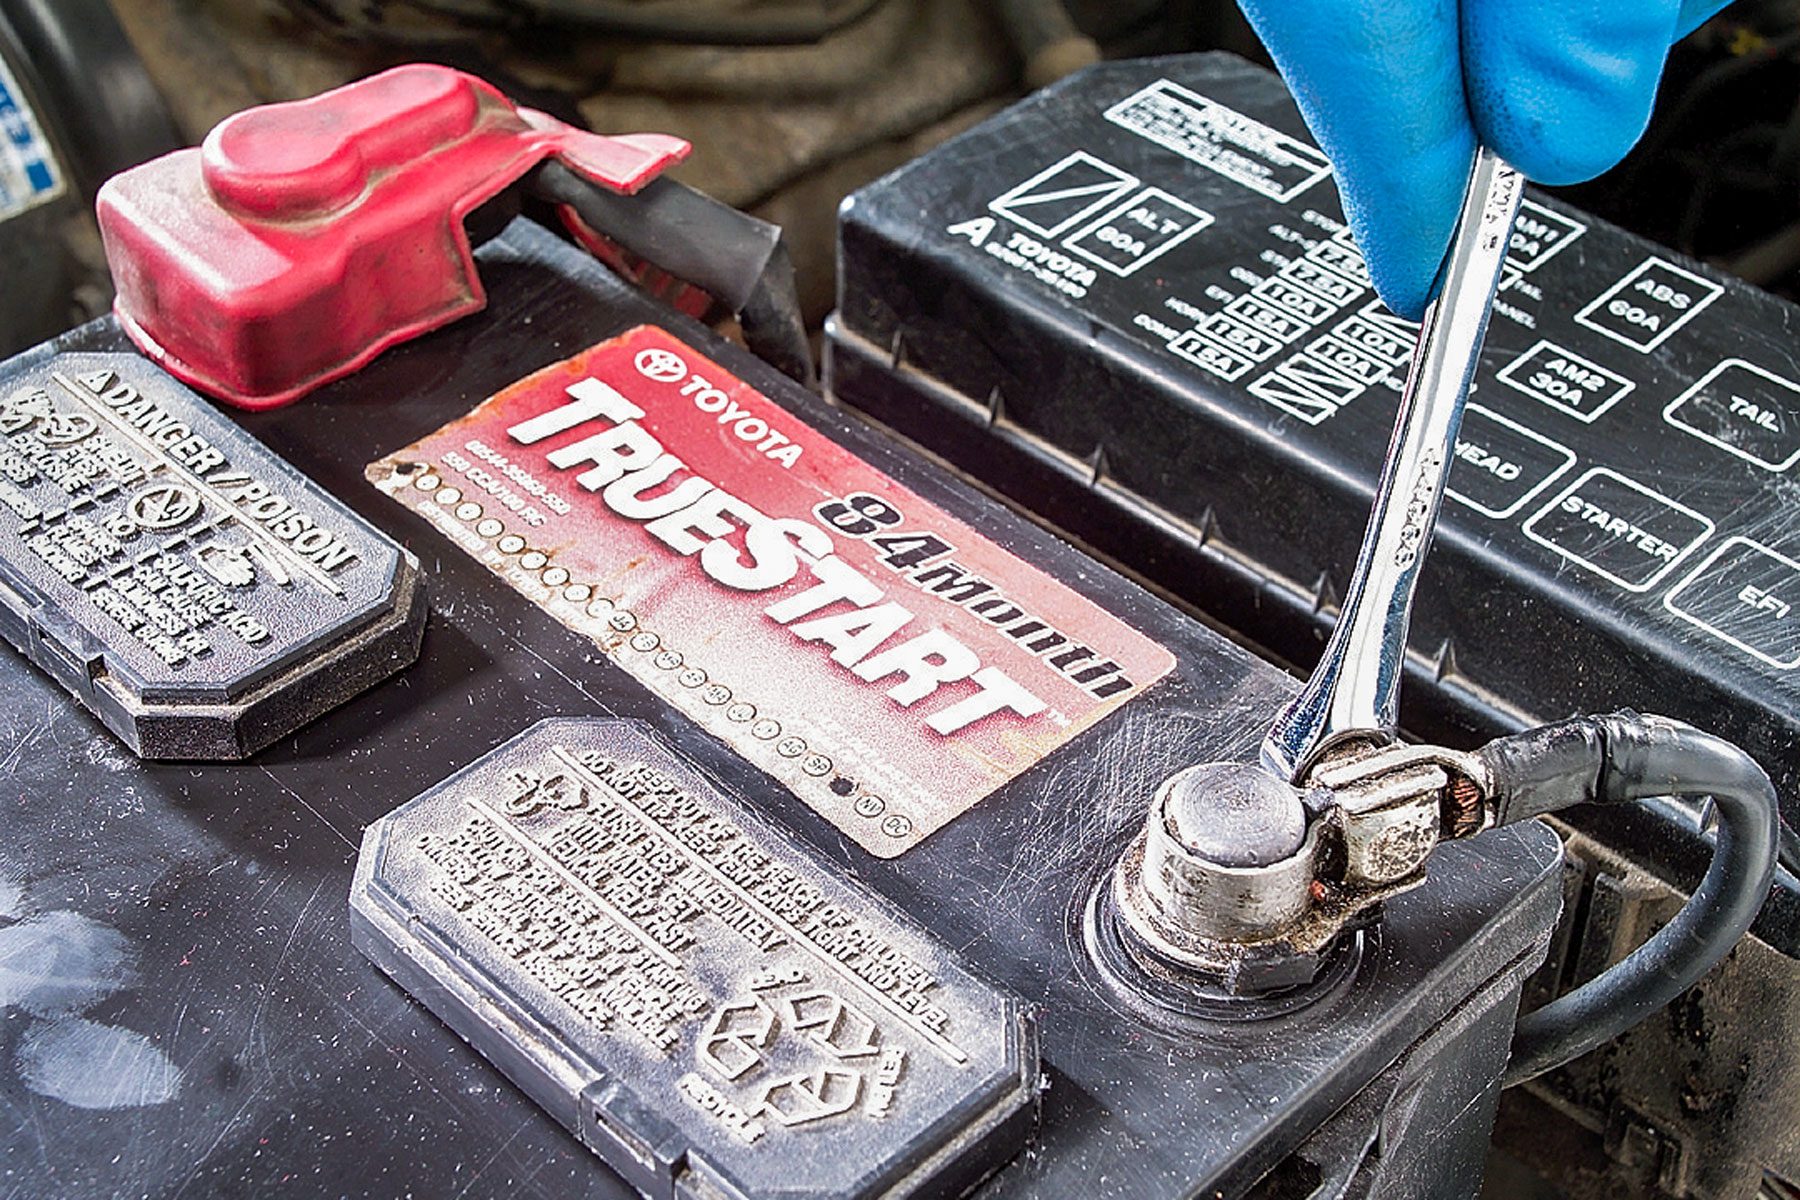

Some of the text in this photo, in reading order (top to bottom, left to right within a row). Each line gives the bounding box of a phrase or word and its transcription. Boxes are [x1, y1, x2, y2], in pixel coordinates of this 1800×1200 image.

[1126, 207, 1182, 236] ALT
[1007, 232, 1097, 286] TOYOTA
[1510, 233, 1539, 256] 0A
[1270, 284, 1318, 315] 10A
[1608, 300, 1663, 332] 60A
[1634, 278, 1691, 310] ABS
[1216, 321, 1264, 351] 15A
[1243, 302, 1290, 332] 15A
[1353, 324, 1400, 354] 10A
[1184, 340, 1233, 369] 15A
[1326, 342, 1372, 373] 10A
[1544, 357, 1606, 391] AM2
[1529, 372, 1584, 406] 30A
[680, 374, 804, 469] TOYOTA
[1730, 396, 1781, 432] TAIL
[4, 431, 90, 493] EXPLOSIVE
[59, 445, 105, 478] EYES
[81, 434, 142, 478] SHIELD
[99, 383, 226, 474] DANGER
[229, 482, 355, 572] POISON
[441, 451, 547, 528] 550 CCA/100 RC
[99, 512, 137, 538] NO
[1561, 496, 1680, 562] STARTER
[107, 575, 209, 654] BLINDNESS OR
[130, 565, 212, 626] CAN CAUSE
[150, 554, 270, 643] SULFURIC ACID
[1738, 585, 1791, 618] EFI
[85, 587, 185, 662] SEVERE BURNS
[446, 833, 508, 879] FOLLOW
[587, 801, 786, 952] FLUSH EYES IMMEDIATELY
[627, 762, 936, 992] KEEP OUT OF THE REACH OF CHILDREN
[537, 830, 693, 951] MEDICAL HELP FAST
[579, 751, 608, 772] DO
[607, 772, 645, 800] NOT
[668, 819, 716, 855] KEEP
[710, 851, 760, 888] VENT
[795, 915, 857, 961] TIGHT
[850, 956, 894, 989] AND
[889, 985, 951, 1031] LEVEL
[655, 890, 696, 920] GET
[523, 867, 558, 892] FOR
[628, 950, 709, 1011] STARTING
[677, 1073, 766, 1143] RECYCLE
